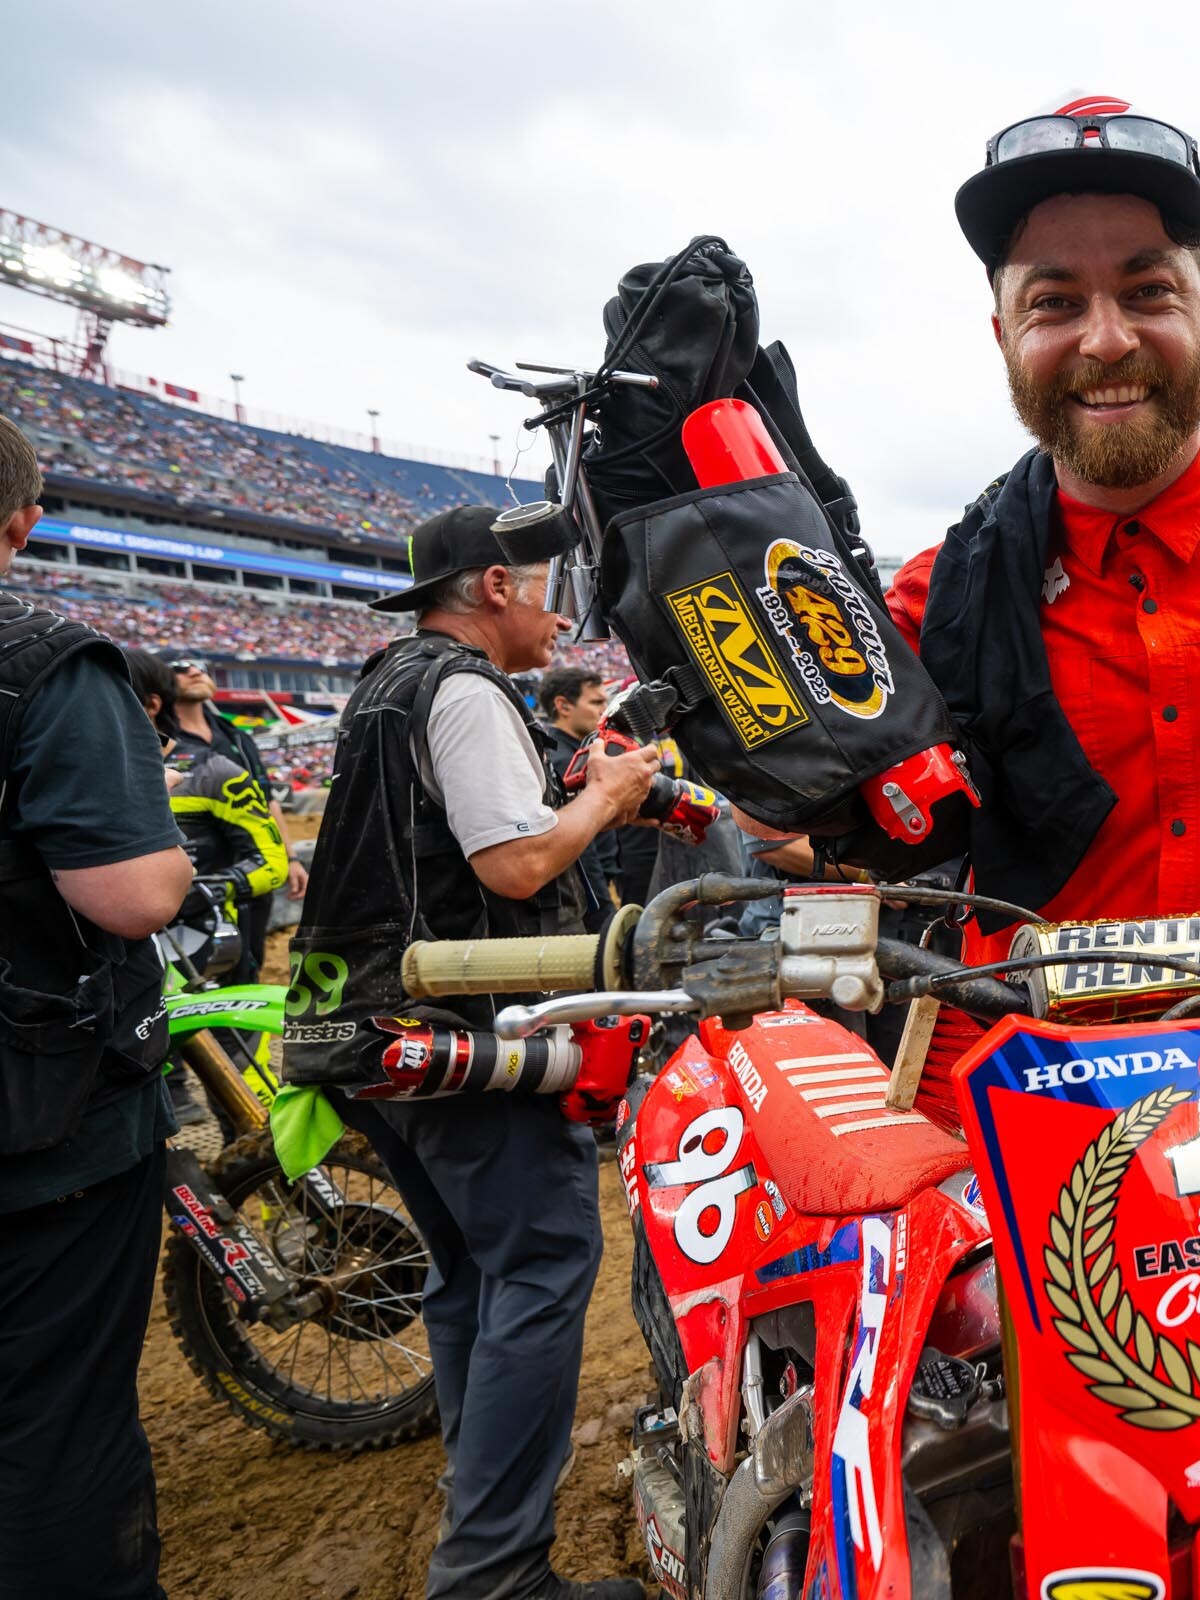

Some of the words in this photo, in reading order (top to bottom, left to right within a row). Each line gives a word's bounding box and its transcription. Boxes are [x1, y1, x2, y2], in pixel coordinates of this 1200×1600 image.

[673, 594, 726, 694] MECHANIX
[757, 586, 793, 636] 1991
[793, 652, 832, 704] 2022
[788, 586, 868, 677] 429
[169, 1001, 268, 1019] CIRCUIT
[727, 1041, 769, 1113] HONDA
[1023, 1048, 1196, 1091] HONDA
[173, 1184, 226, 1240] BRAKING
[641, 1106, 758, 1265] 96
[832, 1218, 893, 1573] CRF
